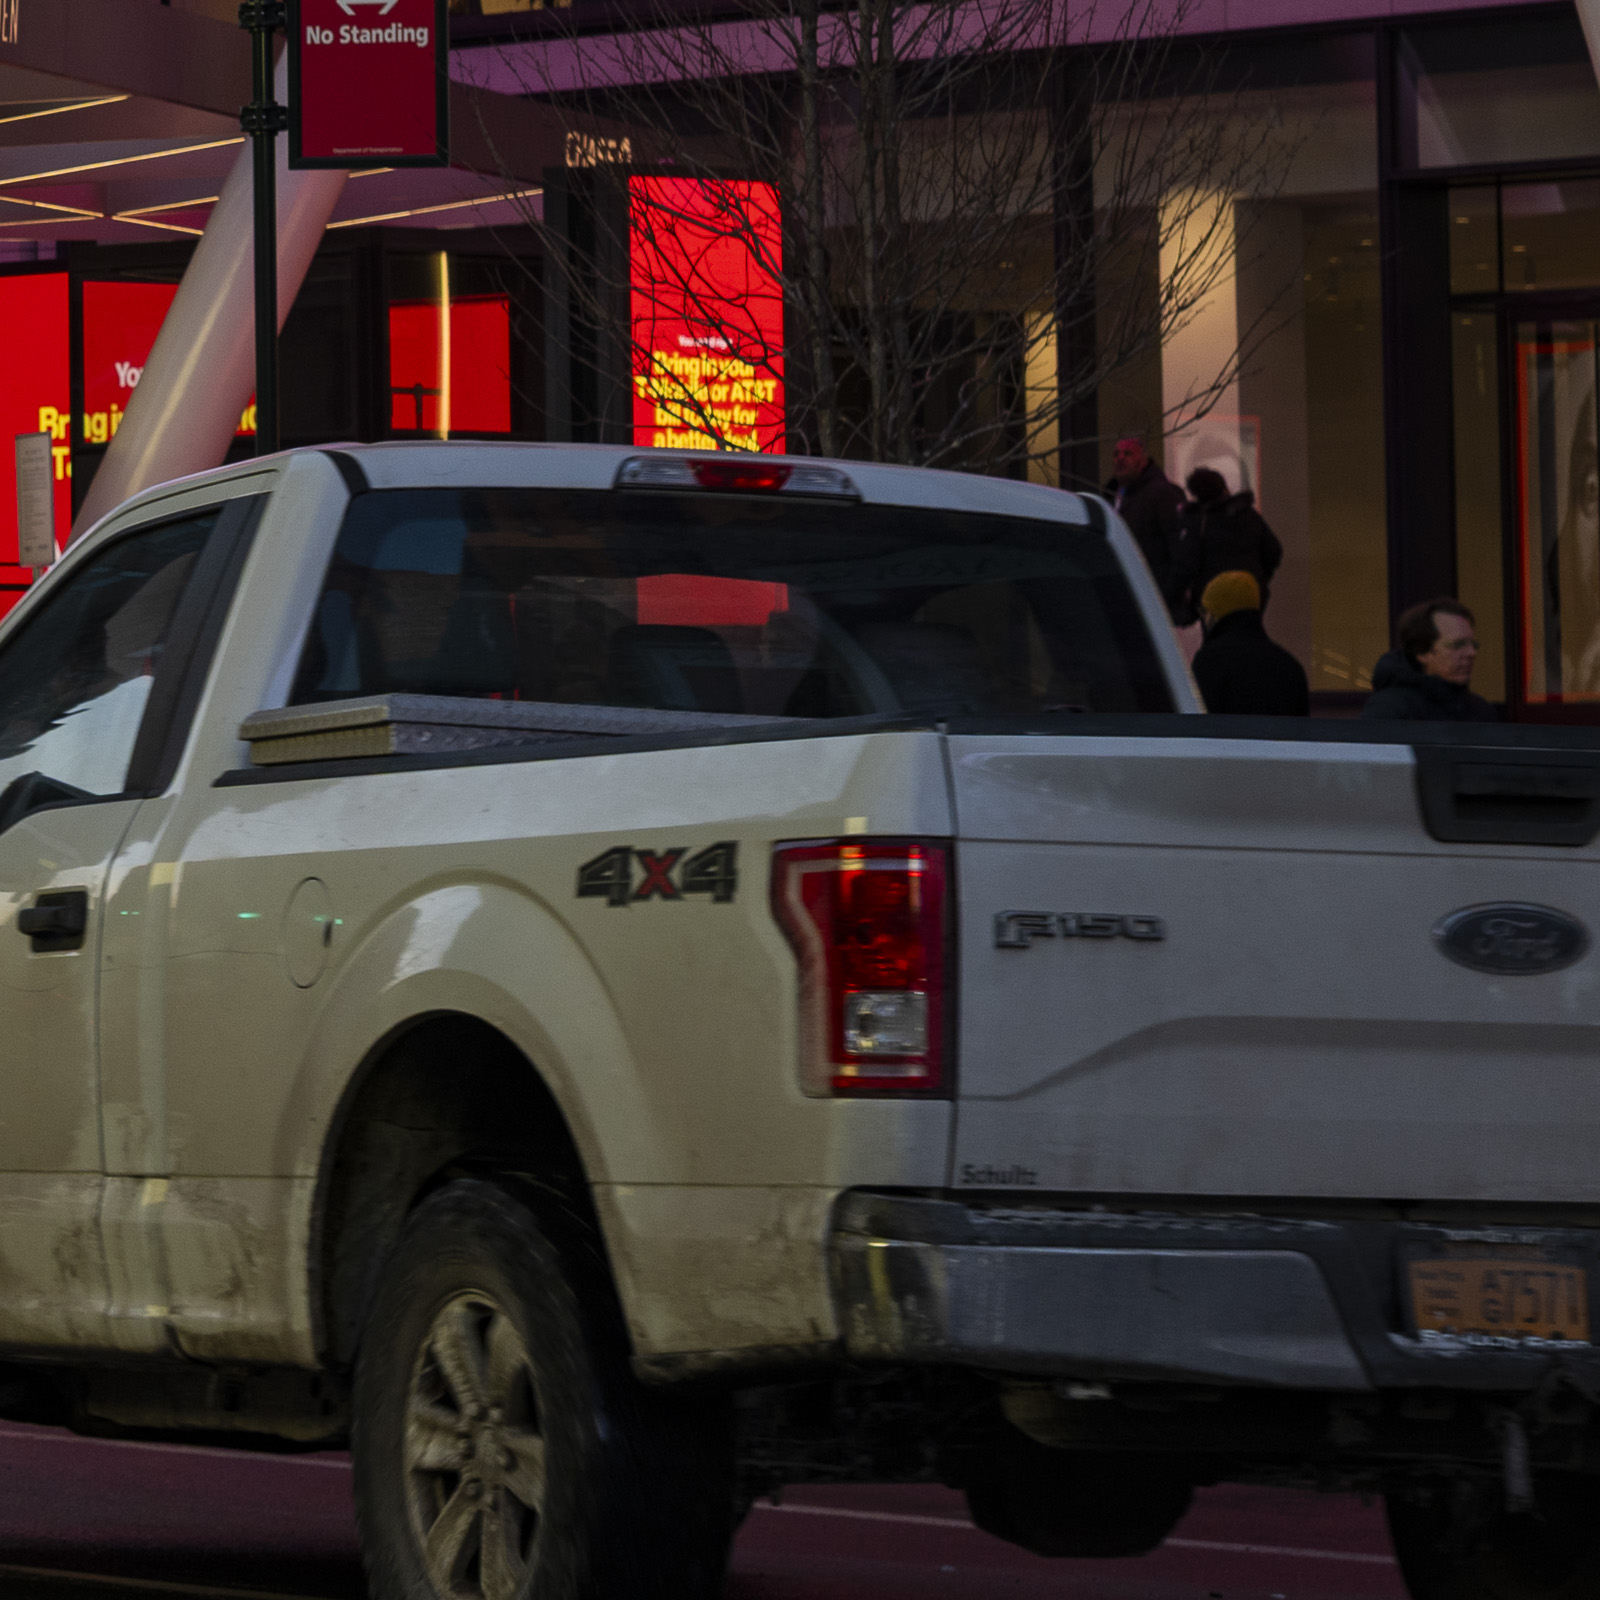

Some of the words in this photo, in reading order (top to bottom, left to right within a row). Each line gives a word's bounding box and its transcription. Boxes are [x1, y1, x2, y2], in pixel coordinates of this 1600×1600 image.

[306, 25, 334, 46] No
[339, 23, 429, 50] Standing
[961, 1163, 1038, 1186] Schultz
